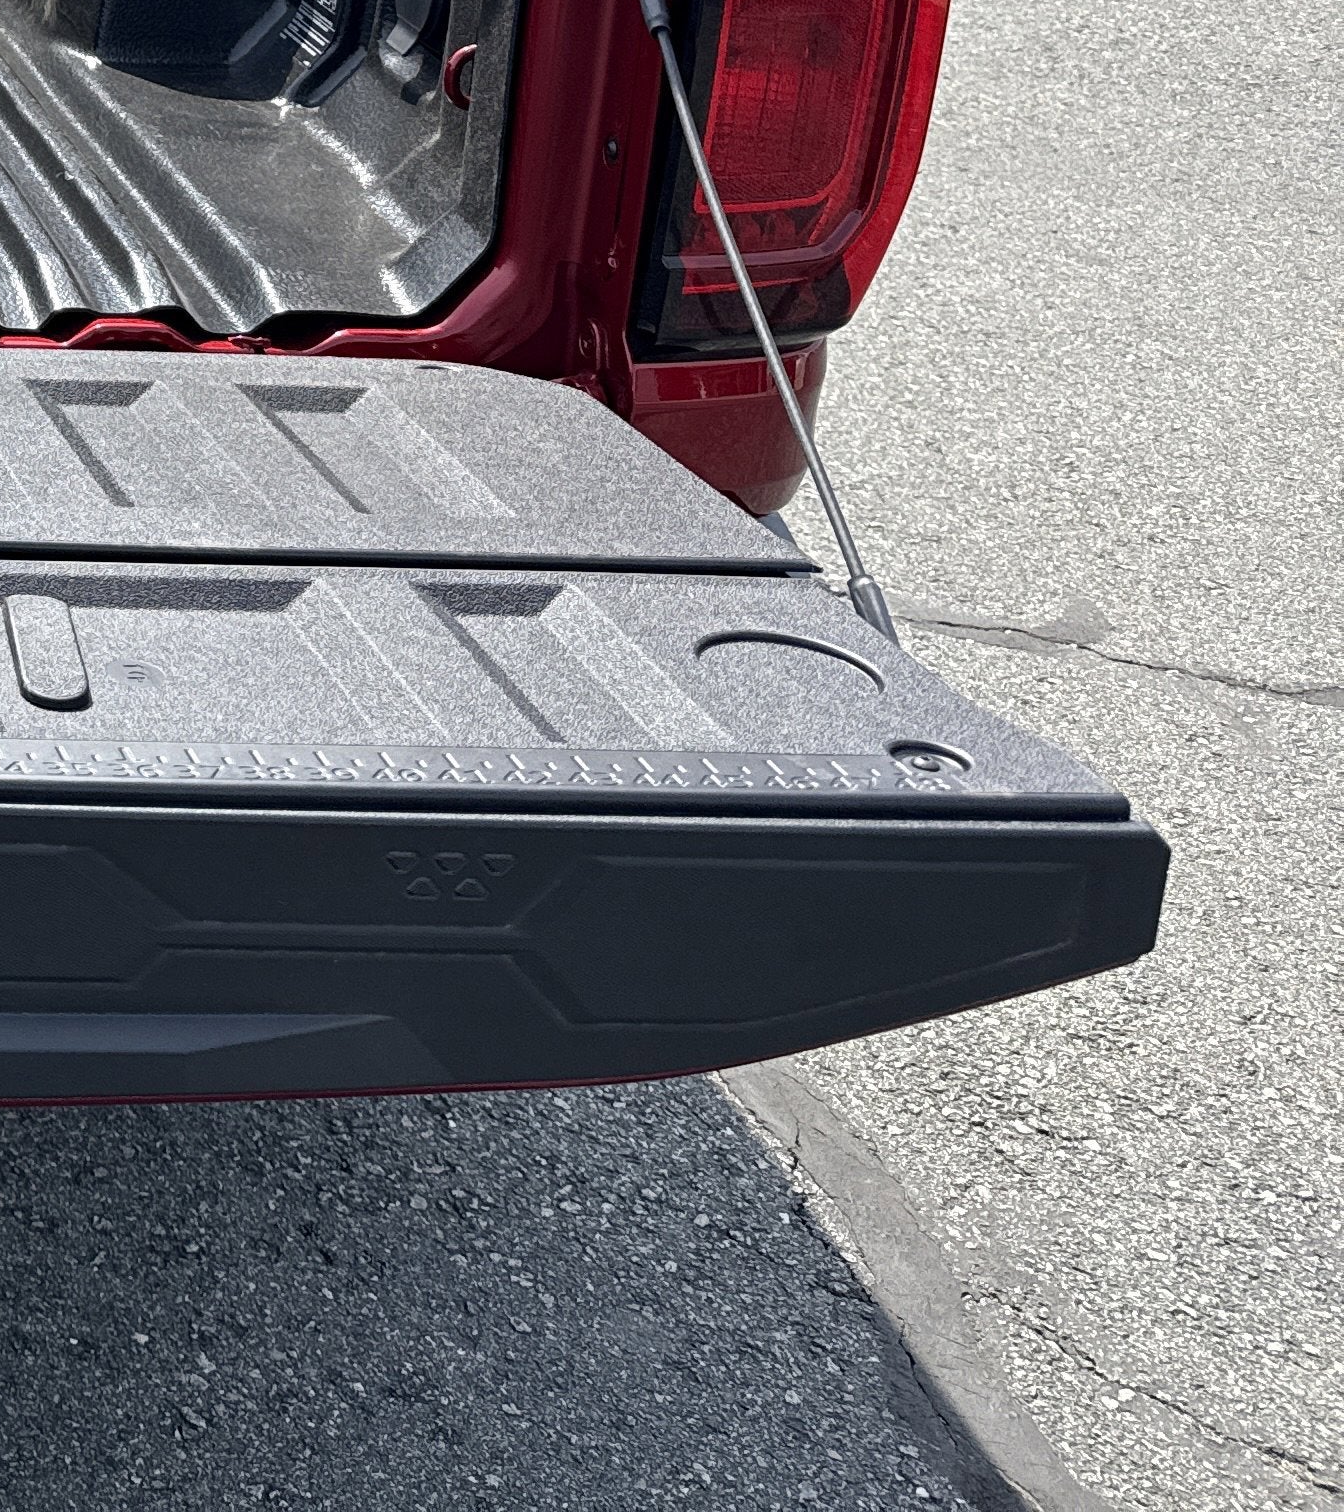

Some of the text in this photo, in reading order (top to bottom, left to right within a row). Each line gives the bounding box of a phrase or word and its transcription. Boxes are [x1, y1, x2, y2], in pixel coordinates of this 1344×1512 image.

[42, 761, 97, 775] 35
[108, 762, 164, 777] 36
[173, 764, 225, 779] 37
[238, 766, 296, 779] 38
[303, 767, 359, 780] 39
[371, 768, 427, 782] 40
[437, 769, 495, 783] 41
[503, 771, 560, 785] 42
[568, 771, 623, 786] 43
[634, 772, 689, 787] 44
[700, 773, 754, 788] 45
[895, 778, 951, 790] 48
